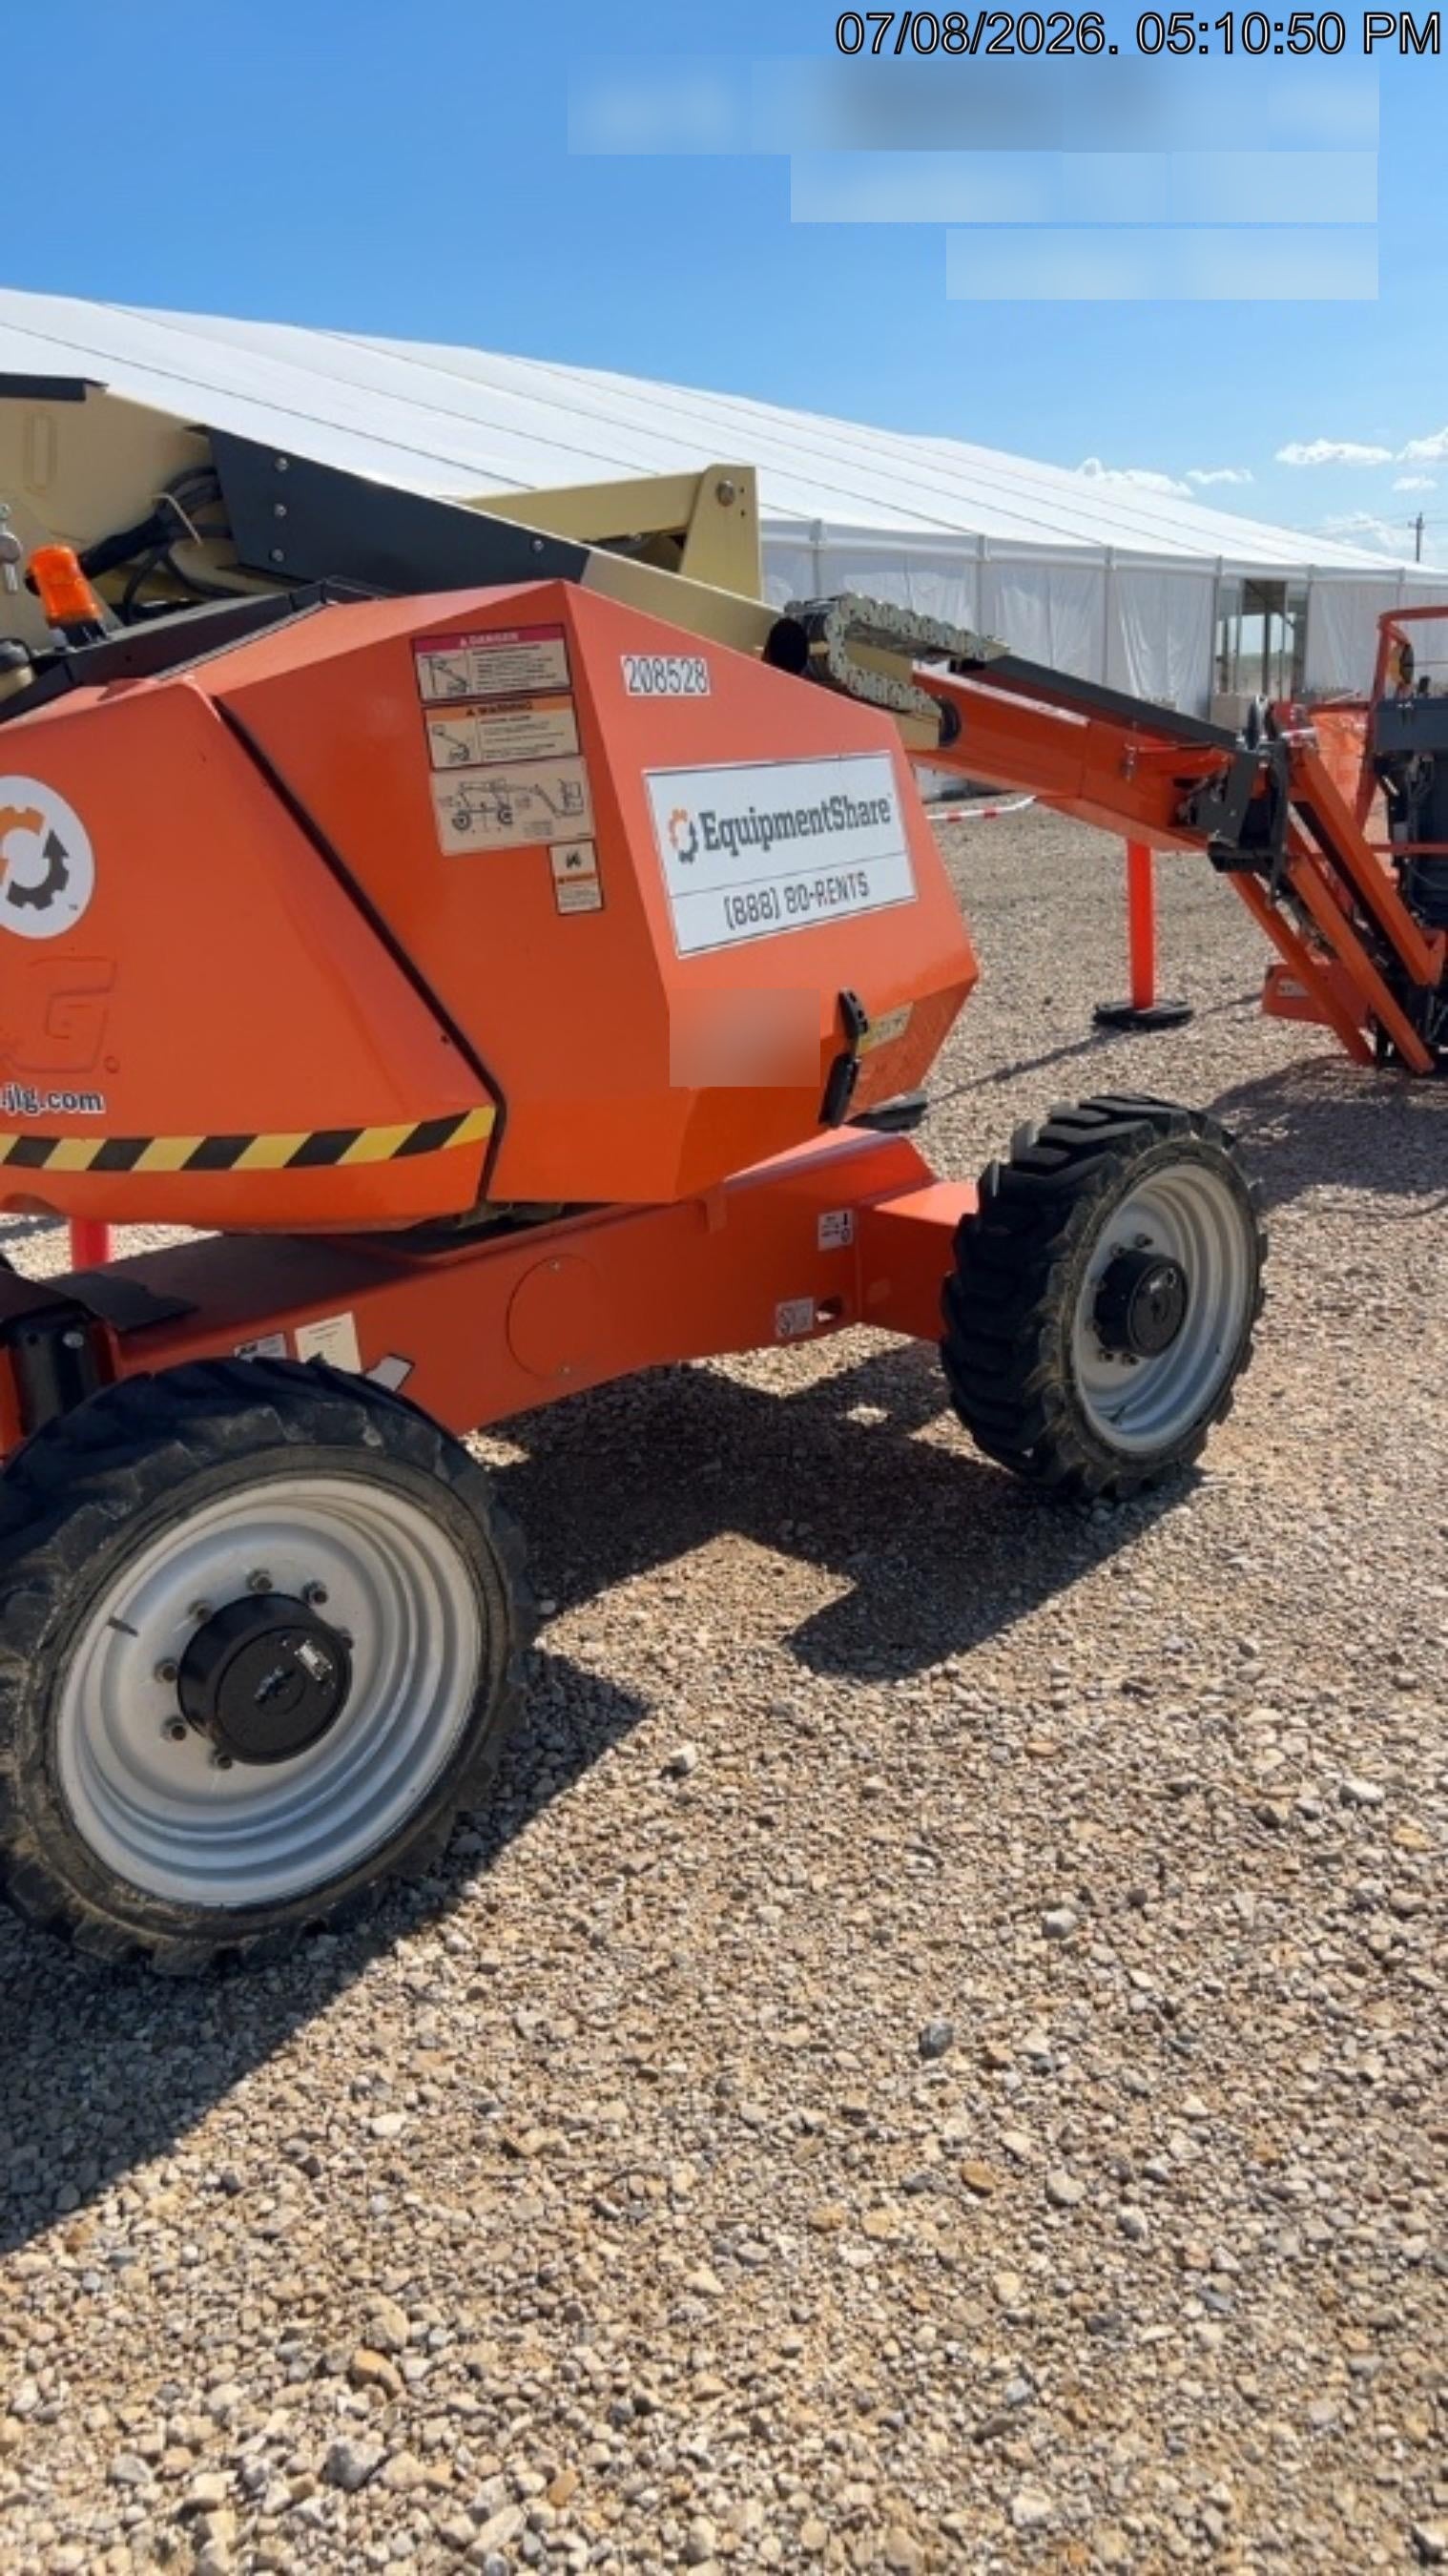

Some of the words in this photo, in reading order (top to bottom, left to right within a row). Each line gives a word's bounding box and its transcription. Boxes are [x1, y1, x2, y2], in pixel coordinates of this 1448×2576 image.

[624, 656, 708, 694] 208528
[698, 795, 892, 858] EquipmentShare
[723, 886, 781, 931] (888)
[783, 871, 870, 914] 80-RENTS
